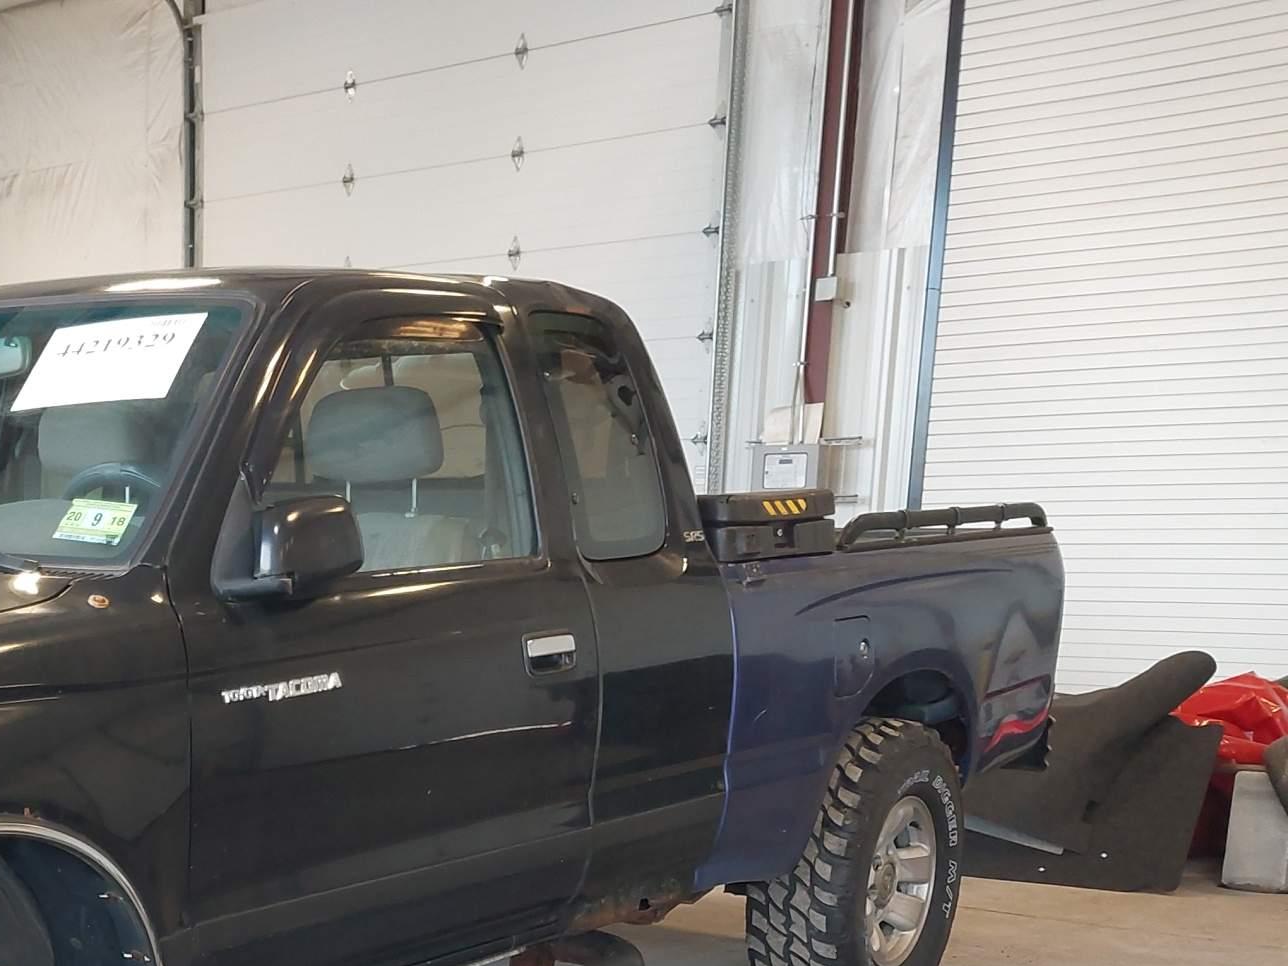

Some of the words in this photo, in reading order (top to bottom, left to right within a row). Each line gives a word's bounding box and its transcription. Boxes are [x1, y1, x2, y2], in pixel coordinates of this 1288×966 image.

[66, 511, 83, 522] 20
[91, 512, 104, 527] 9
[111, 516, 126, 527] 18
[264, 672, 342, 701] TACOMA
[932, 775, 958, 847] DIGGER
[942, 859, 958, 918] M/T
